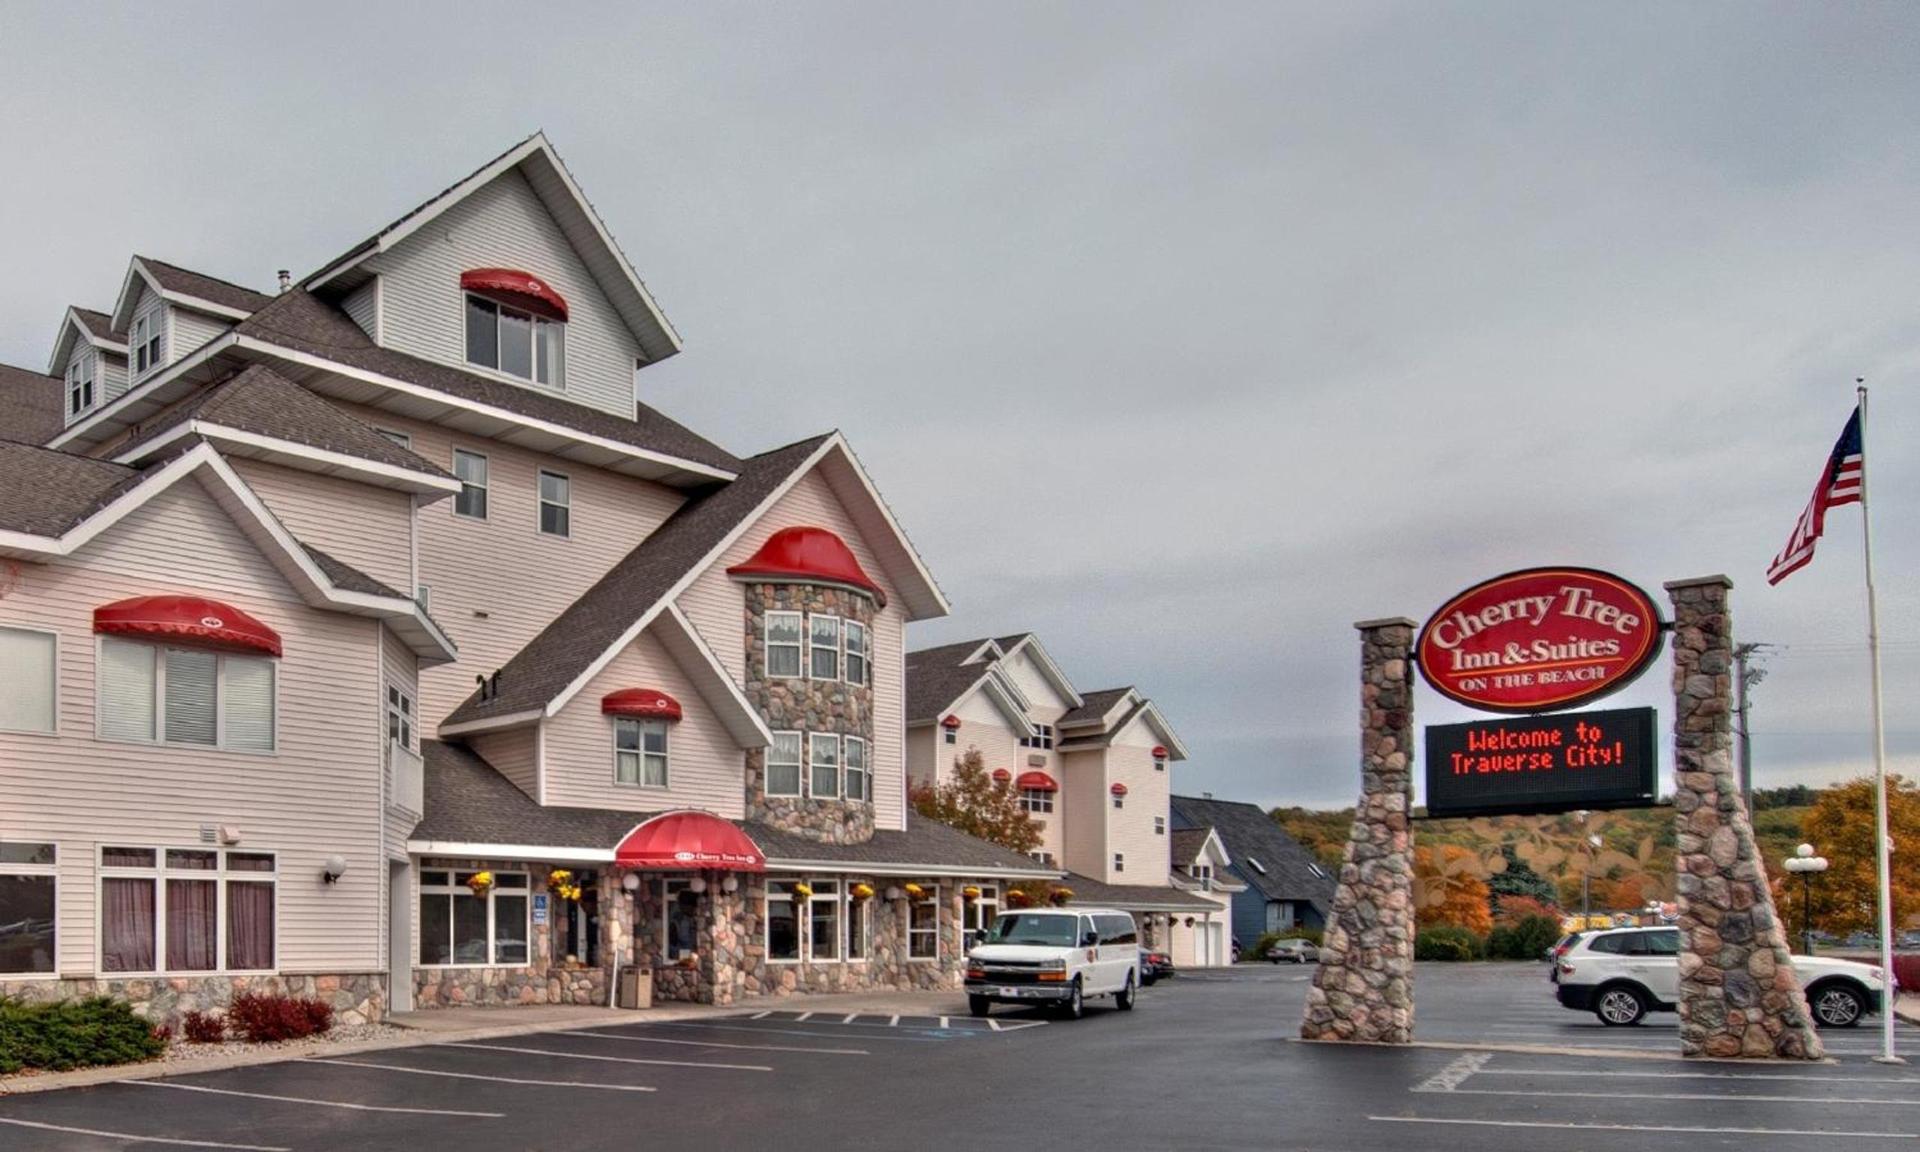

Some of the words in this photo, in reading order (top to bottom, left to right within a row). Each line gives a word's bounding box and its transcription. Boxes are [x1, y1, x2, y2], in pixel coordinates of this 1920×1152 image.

[1431, 595, 1556, 649] Cherry
[1559, 585, 1640, 634] Tree
[1458, 678, 1488, 692] ON
[1493, 673, 1535, 688] THE
[1538, 666, 1606, 684] BEACH
[1468, 728, 1562, 751] Welcome
[1576, 721, 1602, 743] to
[1451, 751, 1553, 775] Traverse
[1566, 741, 1623, 767] City!
